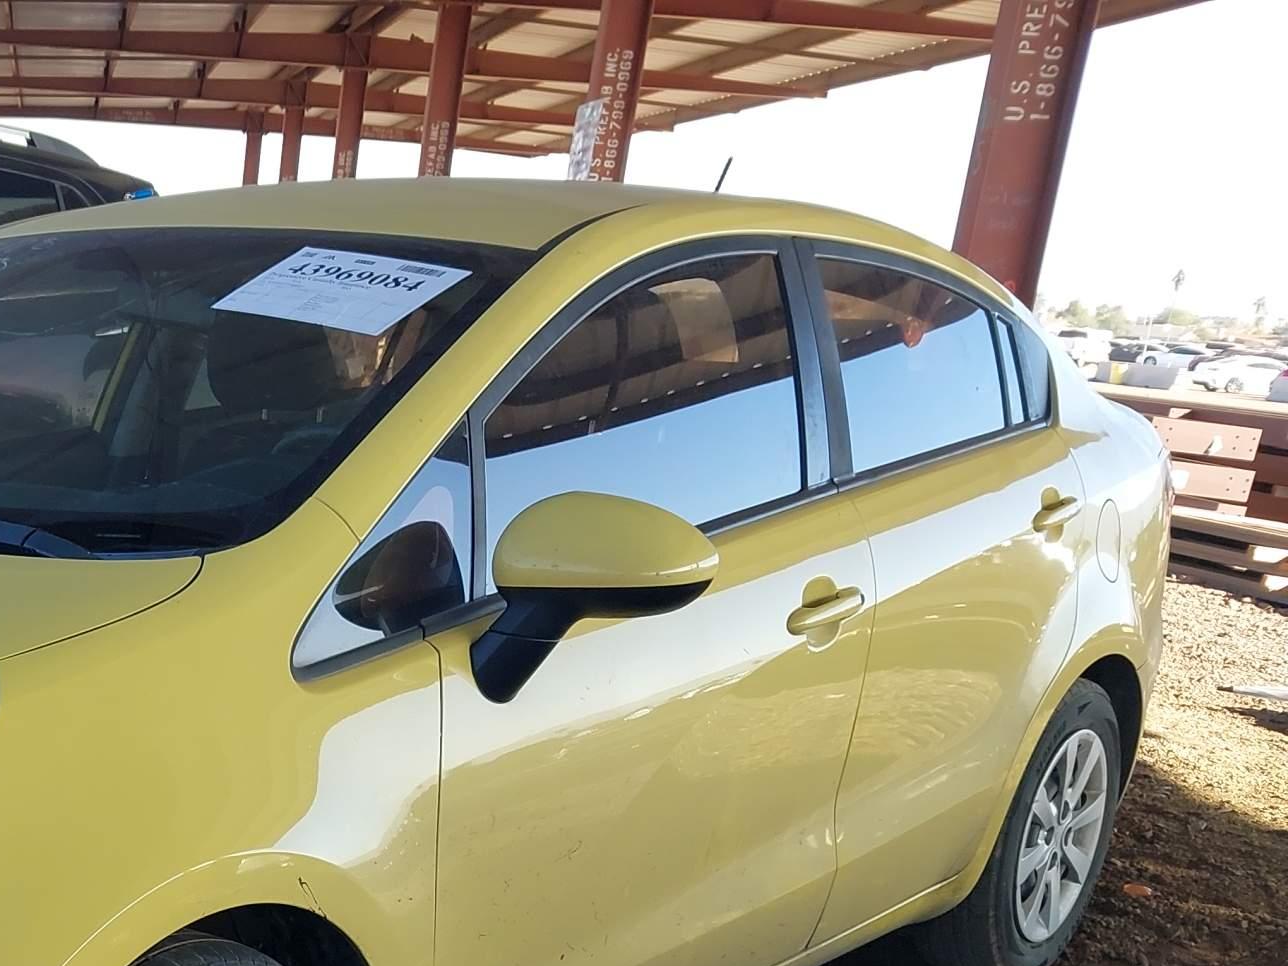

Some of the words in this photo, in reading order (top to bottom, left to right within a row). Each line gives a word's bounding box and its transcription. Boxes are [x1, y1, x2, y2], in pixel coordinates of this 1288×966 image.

[588, 153, 603, 182] U.S.
[604, 48, 620, 78] INC.
[1003, 72, 1033, 121] U.S.
[287, 262, 427, 292] 43969084
